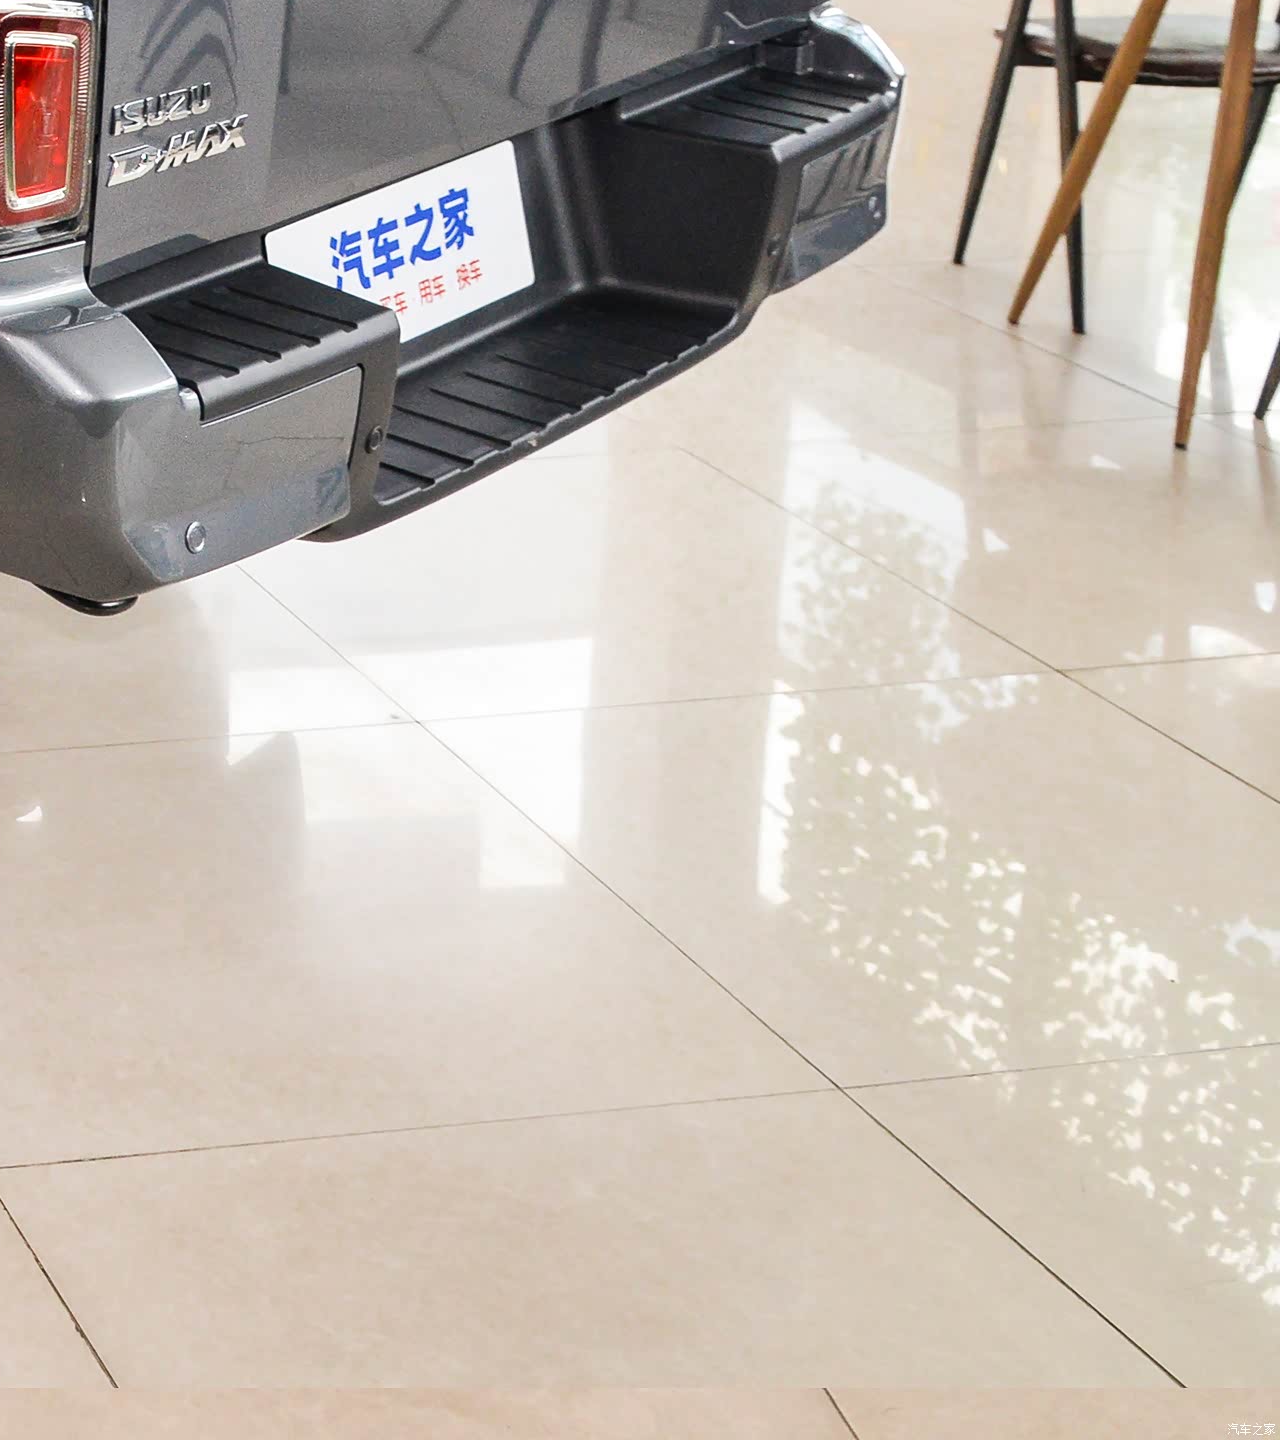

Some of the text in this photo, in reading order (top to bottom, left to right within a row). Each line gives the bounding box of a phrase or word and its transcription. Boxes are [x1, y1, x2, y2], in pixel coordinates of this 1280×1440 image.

[111, 82, 211, 137] ISUZU
[107, 114, 249, 188] D-MAX
[329, 187, 475, 292] 汽车之家
